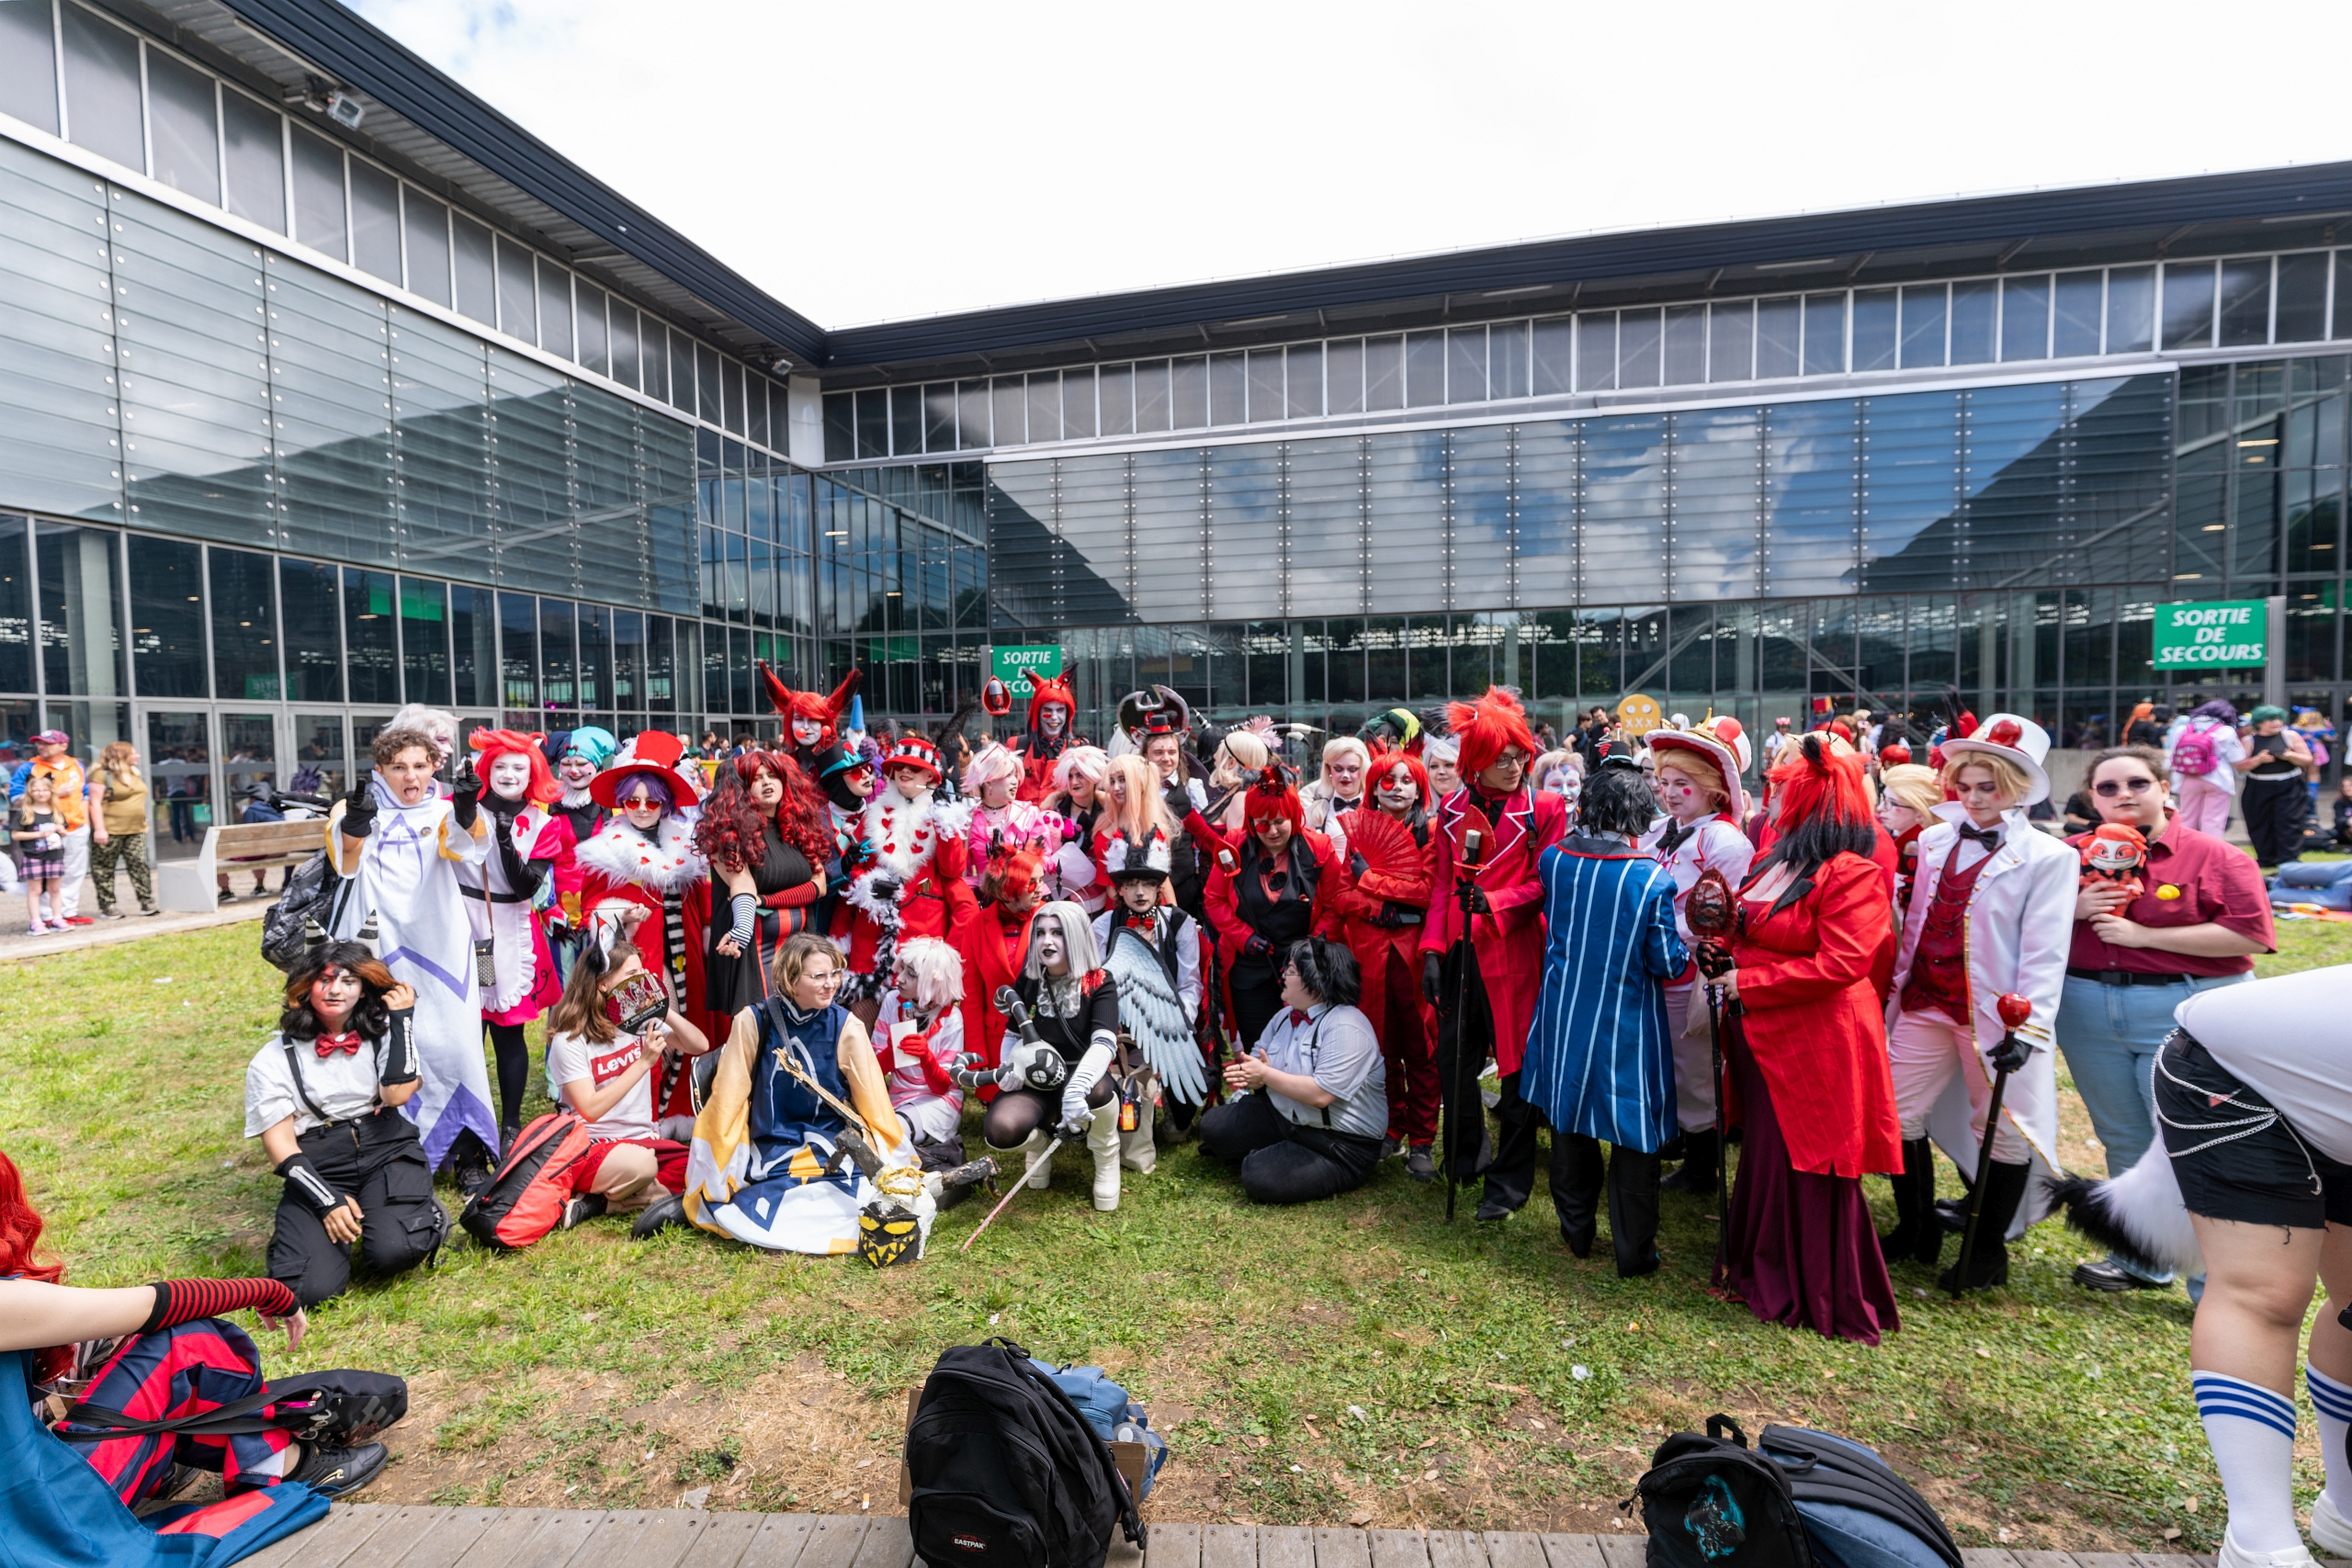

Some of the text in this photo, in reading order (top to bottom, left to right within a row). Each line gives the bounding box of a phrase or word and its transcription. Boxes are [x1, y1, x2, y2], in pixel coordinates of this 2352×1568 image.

[2171, 607, 2252, 627] SORTIE
[2195, 626, 2227, 644] DE
[1002, 650, 1052, 665] SORTIE
[2159, 643, 2264, 663] SECOURS
[954, 1538, 985, 1550] EASTPAK
